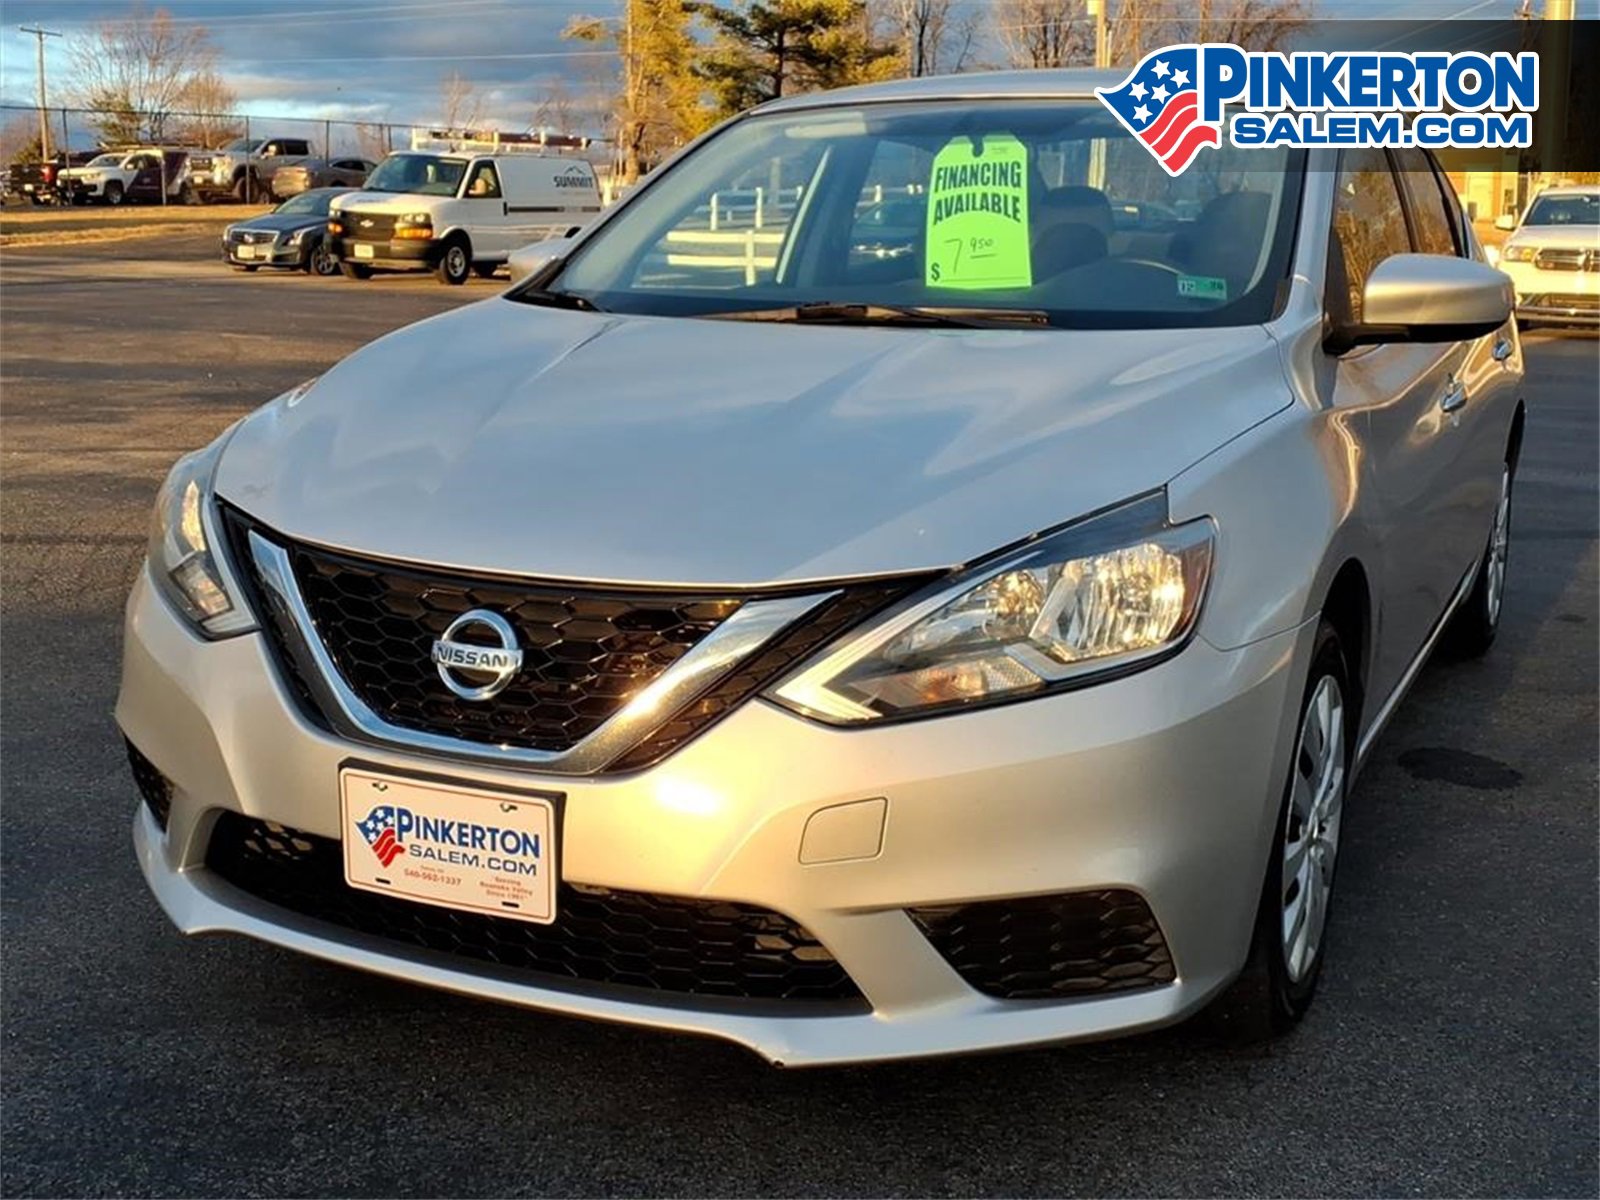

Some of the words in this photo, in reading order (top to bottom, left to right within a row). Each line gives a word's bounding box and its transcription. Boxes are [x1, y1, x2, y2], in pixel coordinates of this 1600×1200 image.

[553, 176, 593, 188] SUMMIT
[934, 161, 1022, 193] FINANCING
[933, 192, 1022, 226] AVAILABLE
[930, 262, 941, 282] $
[437, 645, 508, 668] NISSAN
[396, 807, 541, 860] PINKERTON
[409, 844, 537, 877] SALEM.COM
